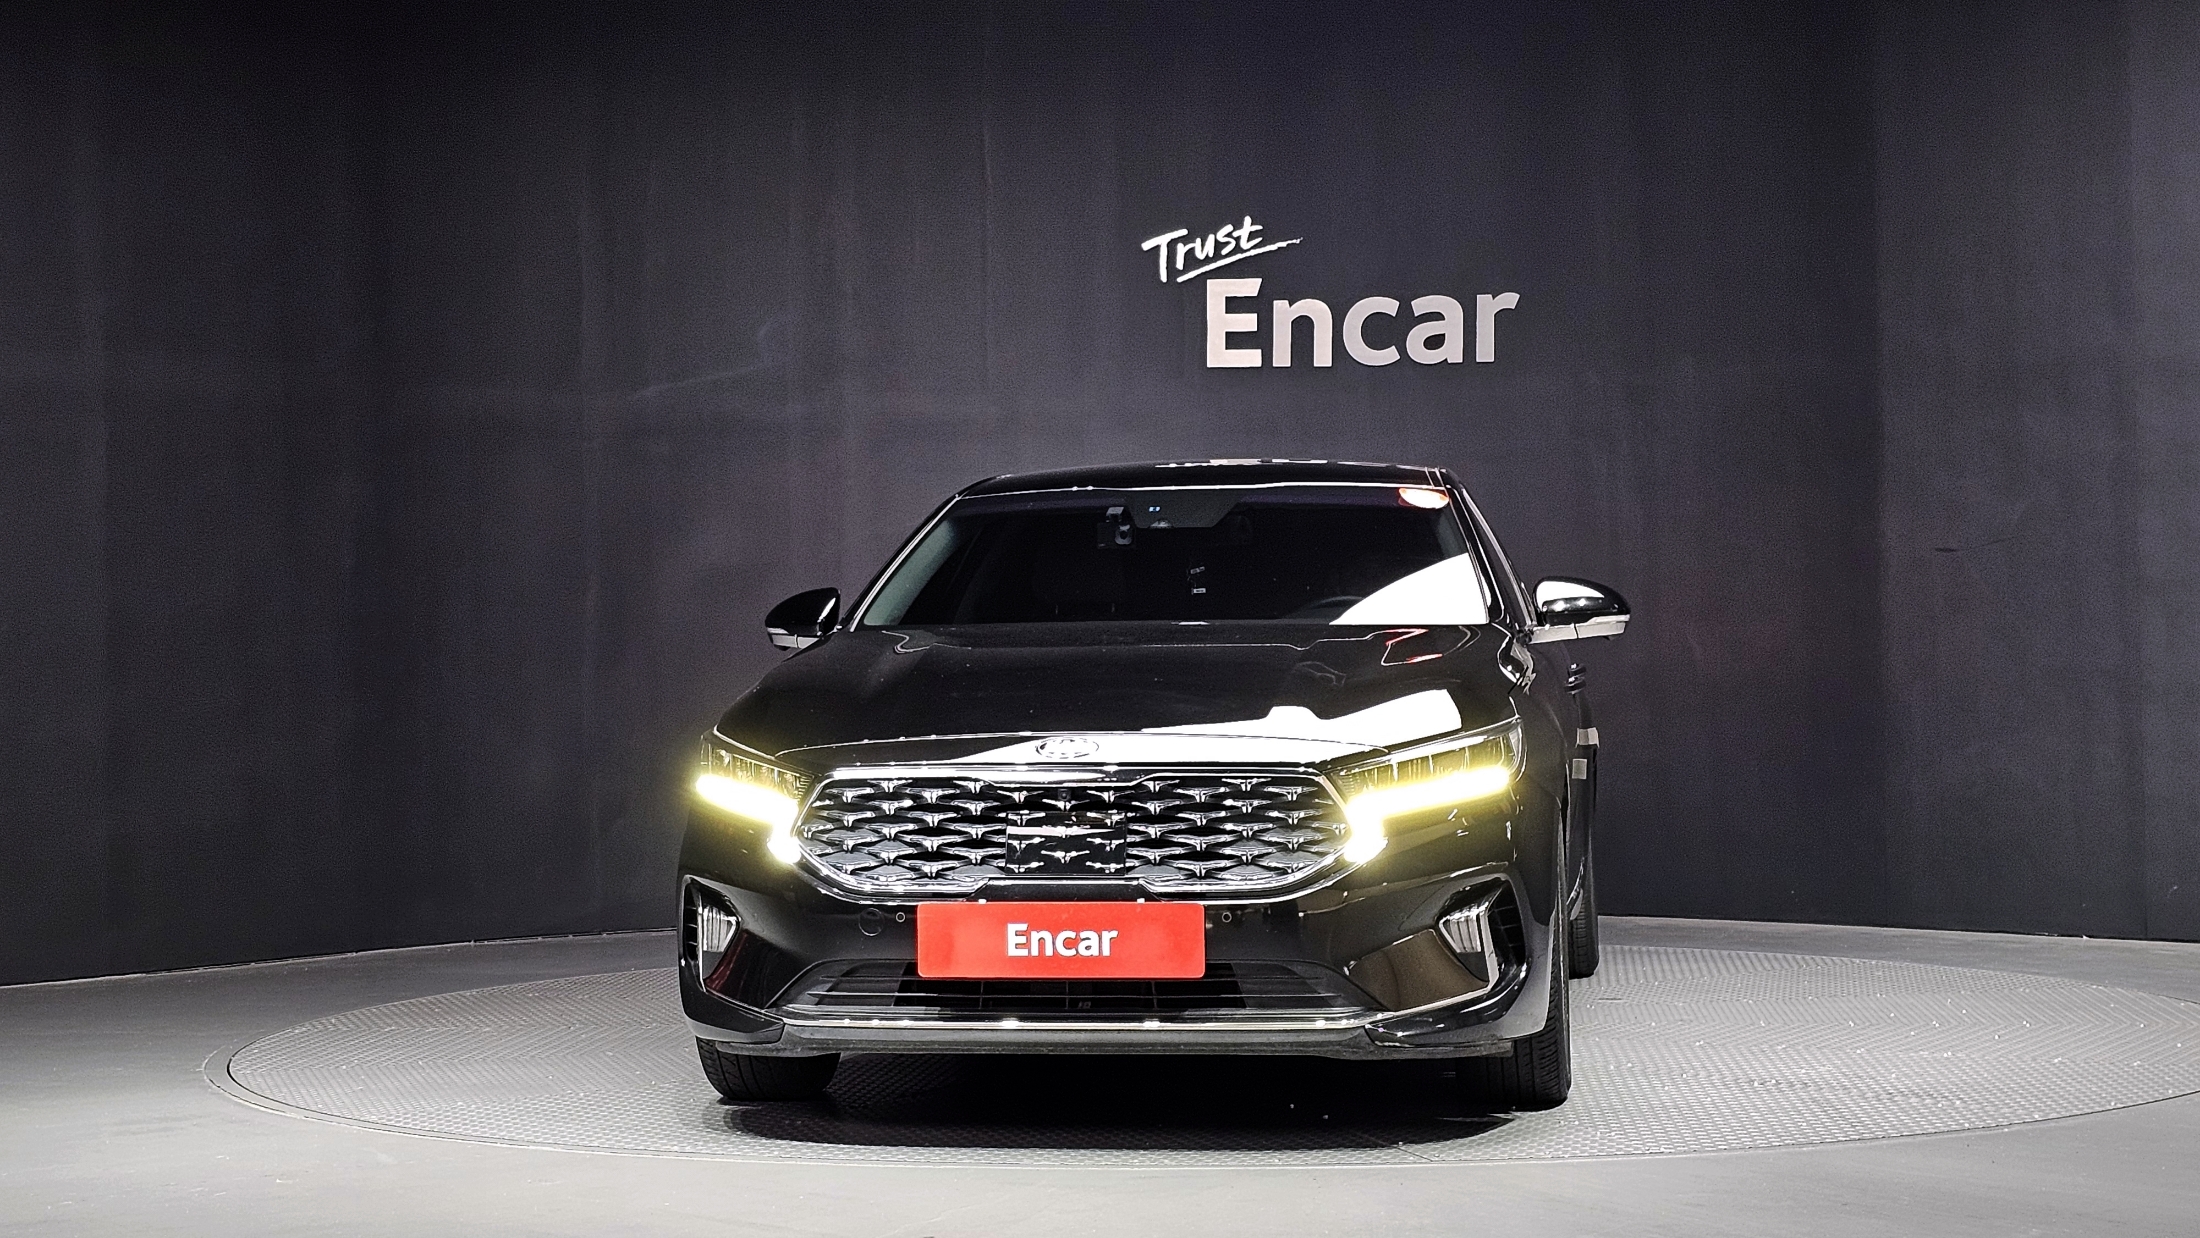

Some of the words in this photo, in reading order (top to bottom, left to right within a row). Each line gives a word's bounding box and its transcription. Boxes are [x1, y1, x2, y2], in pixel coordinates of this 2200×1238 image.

[1141, 215, 1264, 283] Trust
[1206, 277, 1521, 368] Encar
[1006, 922, 1119, 957] Encar
